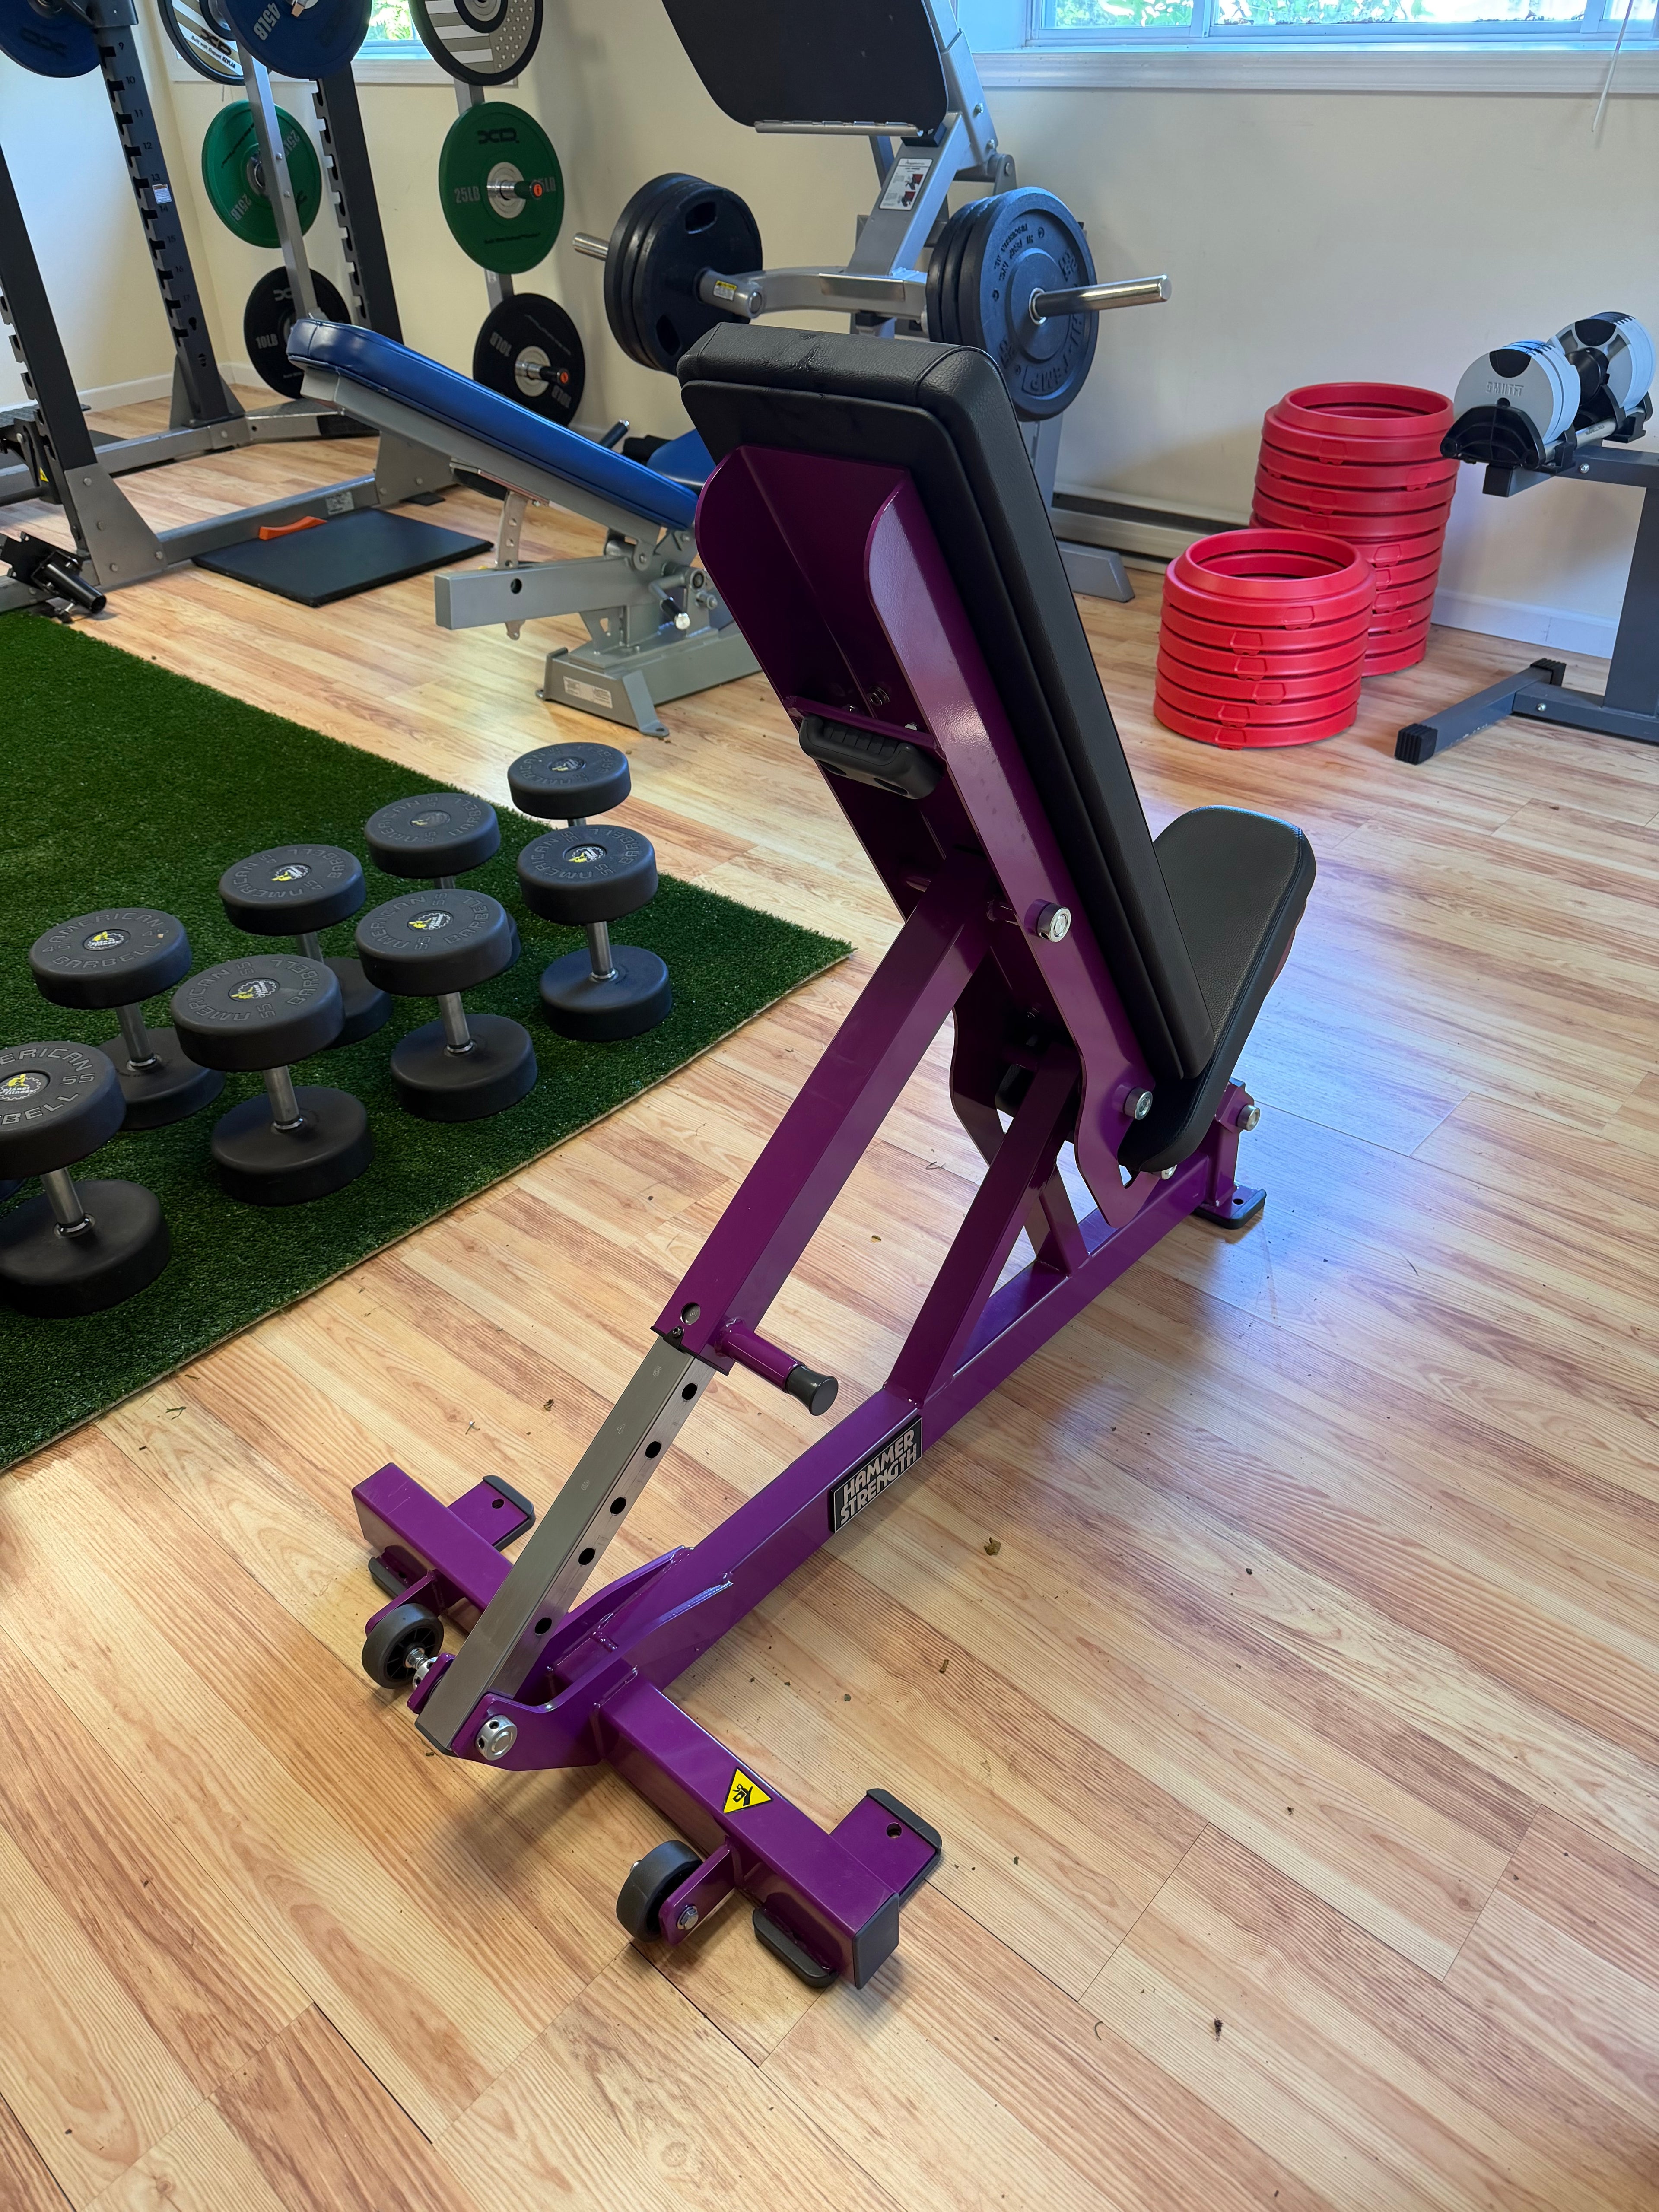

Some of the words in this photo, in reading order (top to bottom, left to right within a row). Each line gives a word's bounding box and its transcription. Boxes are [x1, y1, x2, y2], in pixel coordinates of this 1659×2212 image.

[254, 2, 281, 41] 45LB
[118, 42, 124, 50] 9
[200, 28, 232, 56] XD
[222, 54, 236, 69] KEVLAR
[230, 193, 252, 221] 25LB
[454, 186, 481, 208] 25LB
[256, 333, 279, 349] 10LB
[427, 796, 438, 807] 45
[378, 800, 420, 842] AMERICAN
[448, 797, 482, 836] BARBELL
[425, 830, 436, 842] 45
[562, 831, 579, 842] 55
[588, 828, 641, 865] BARBELL
[259, 854, 277, 864] 45
[287, 848, 345, 879] BARBELL
[531, 838, 593, 879] AMERICAN
[594, 863, 615, 876] 55
[233, 862, 304, 898] AMERICAN
[303, 879, 324, 890] 45
[432, 892, 448, 906] 55
[48, 912, 165, 943] AMERICAN
[371, 896, 426, 949] AMERICAN
[444, 895, 489, 944] BARBELL
[42, 944, 71, 953] 45
[414, 935, 431, 950] 55
[52, 942, 161, 969] BARBELL
[237, 961, 255, 976] 55
[187, 969, 252, 1021] AMERICAN
[270, 959, 320, 1006] BARBELL
[257, 1003, 276, 1019] 55
[0, 1048, 93, 1072] ERICAN
[60, 1073, 95, 1085] 55
[0, 1093, 79, 1125] BELL
[617, 1424, 626, 1434] 4
[843, 1430, 915, 1506] HAMMER
[840, 1443, 917, 1526] STRENGTH
